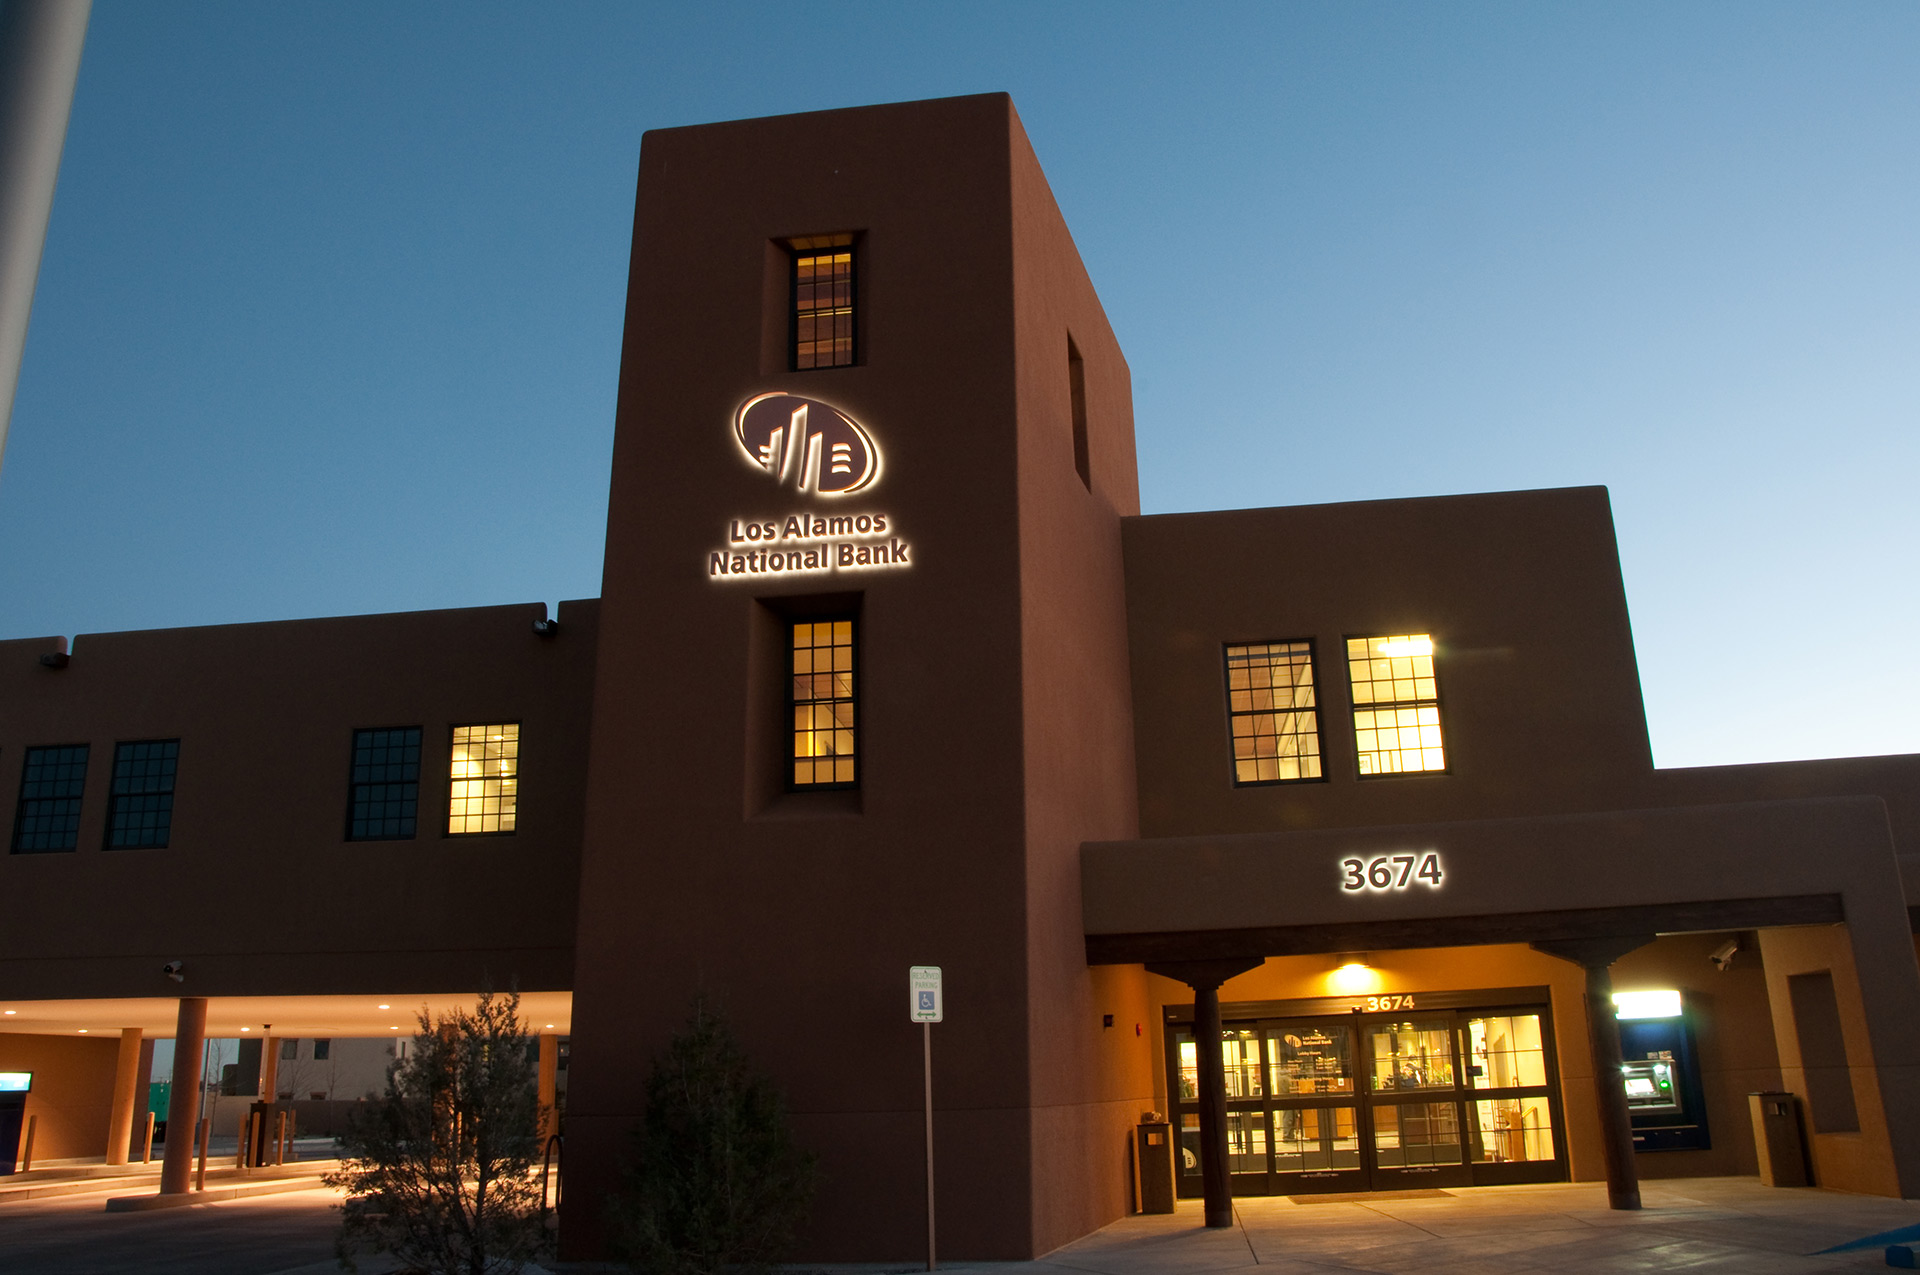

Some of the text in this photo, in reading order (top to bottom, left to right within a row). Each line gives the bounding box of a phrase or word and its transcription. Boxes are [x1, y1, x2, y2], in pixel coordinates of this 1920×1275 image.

[731, 513, 887, 543] Los Alamos
[709, 538, 908, 575] National Bank
[1343, 854, 1442, 890] 3674
[1367, 994, 1415, 1012] 3674
